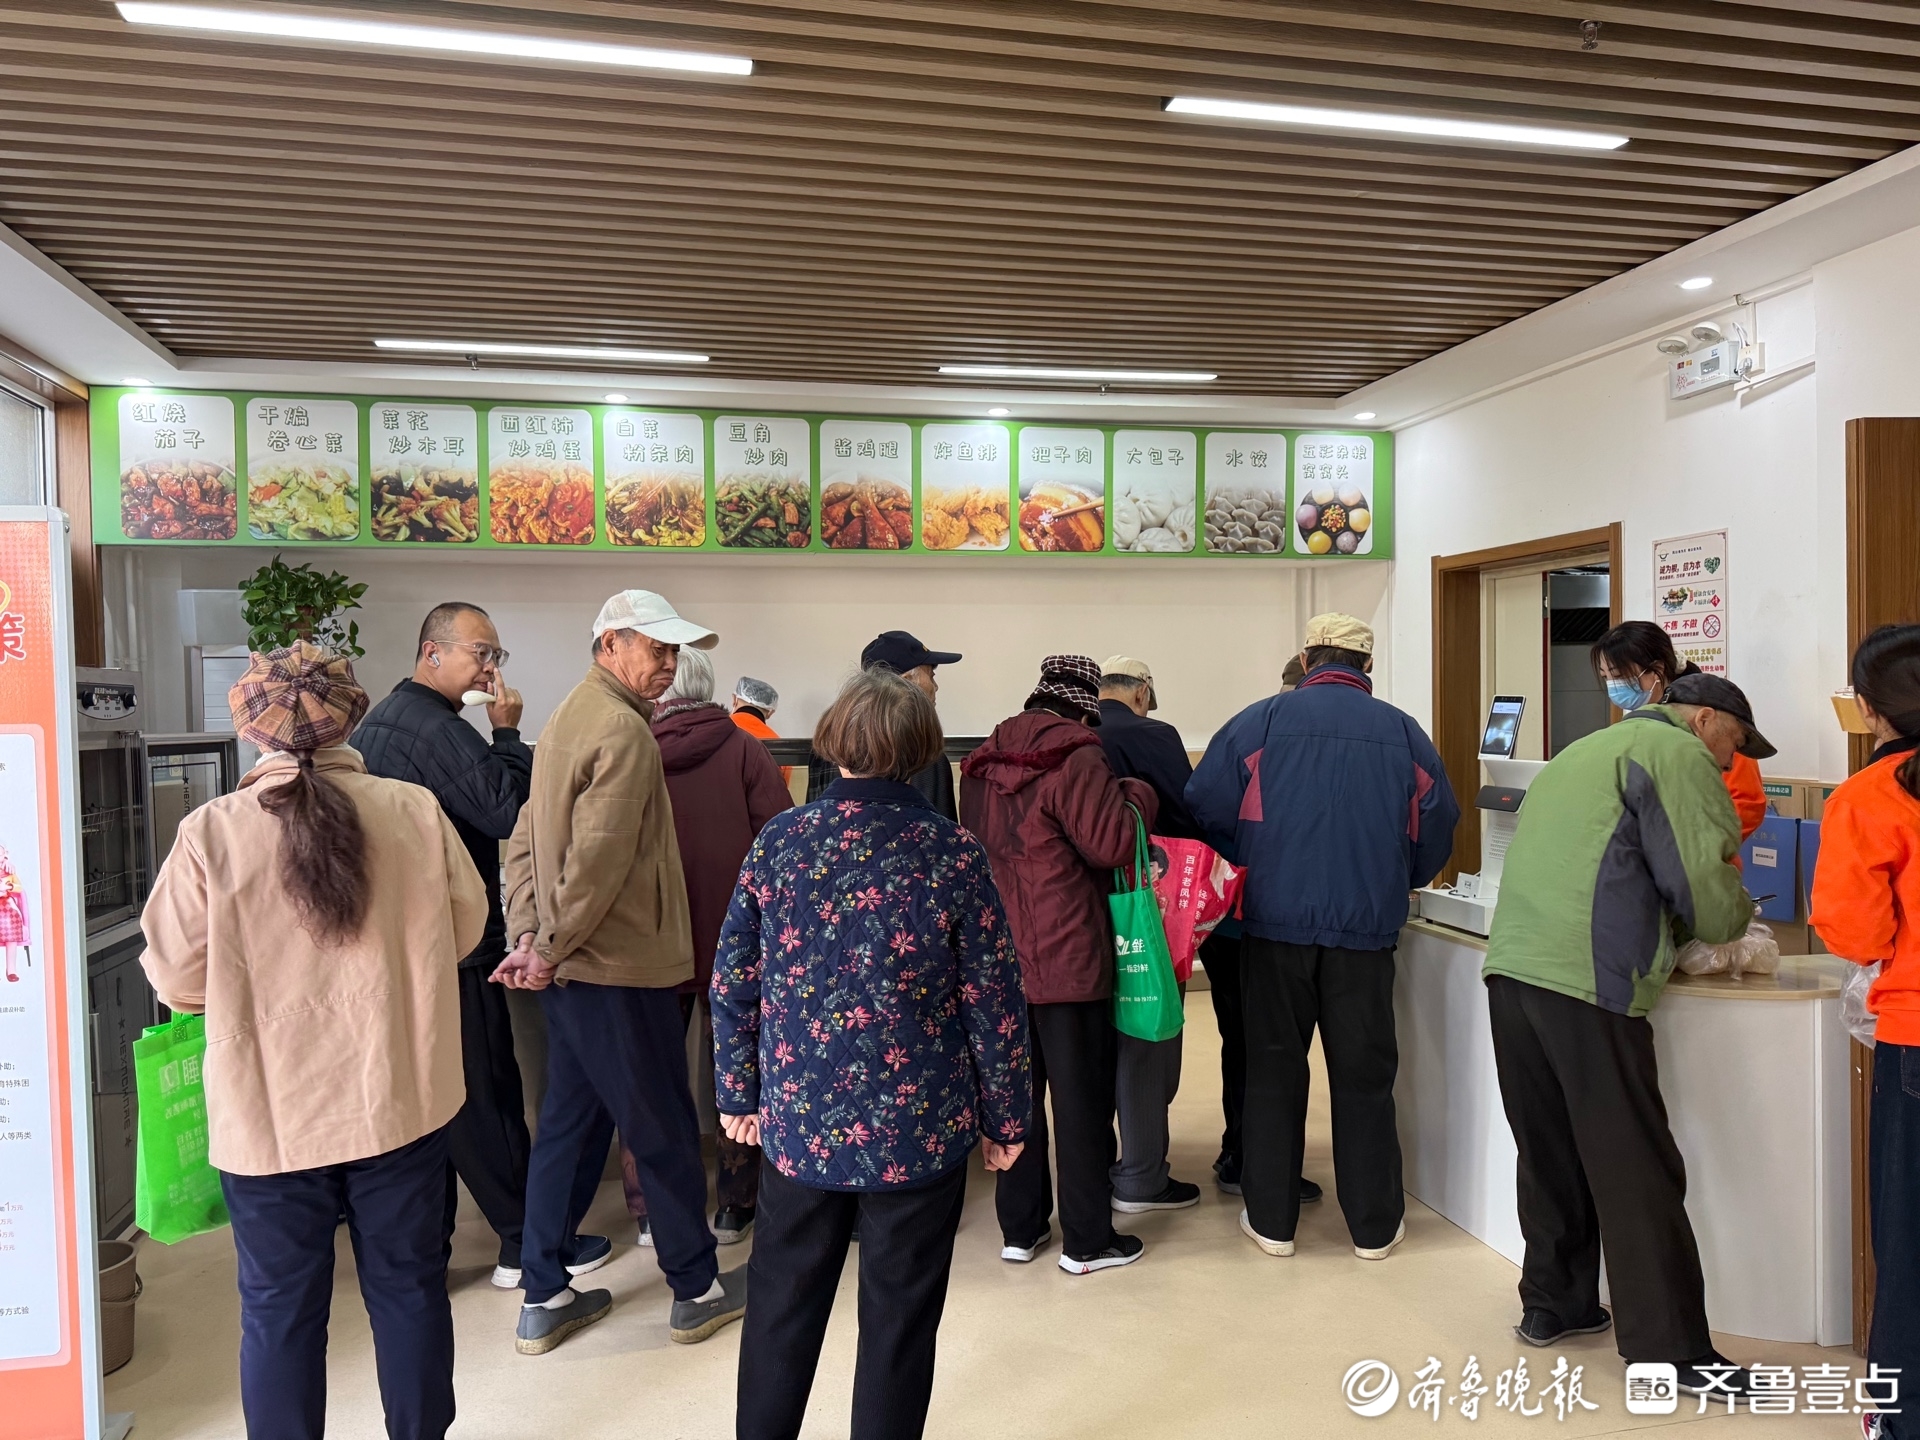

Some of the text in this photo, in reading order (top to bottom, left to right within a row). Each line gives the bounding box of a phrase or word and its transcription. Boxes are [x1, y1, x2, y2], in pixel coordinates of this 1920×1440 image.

[132, 403, 186, 424] 红烧
[258, 406, 309, 427] 干煸
[382, 410, 429, 431] 菜花
[500, 414, 574, 436] 西红柿
[616, 419, 659, 439] 白菜
[729, 423, 771, 443] 豆角
[154, 428, 205, 450] 茄子
[267, 431, 343, 453] 卷心菜
[389, 436, 465, 456] 炒木耳
[834, 439, 899, 459] 酱鸡腿
[508, 439, 581, 462] 炒鸡蛋
[623, 442, 694, 464] 粉条肉
[744, 447, 788, 467] 炒肉
[933, 440, 997, 463] 炸鱼排
[1031, 446, 1093, 465] 把子肉
[1126, 447, 1185, 466] 大包子
[1226, 448, 1268, 469] 水饺
[1302, 444, 1367, 462] 五彩杂粮
[1302, 464, 1349, 480] 窝窝头
[1179, 855, 1195, 909] 百年老凤祥
